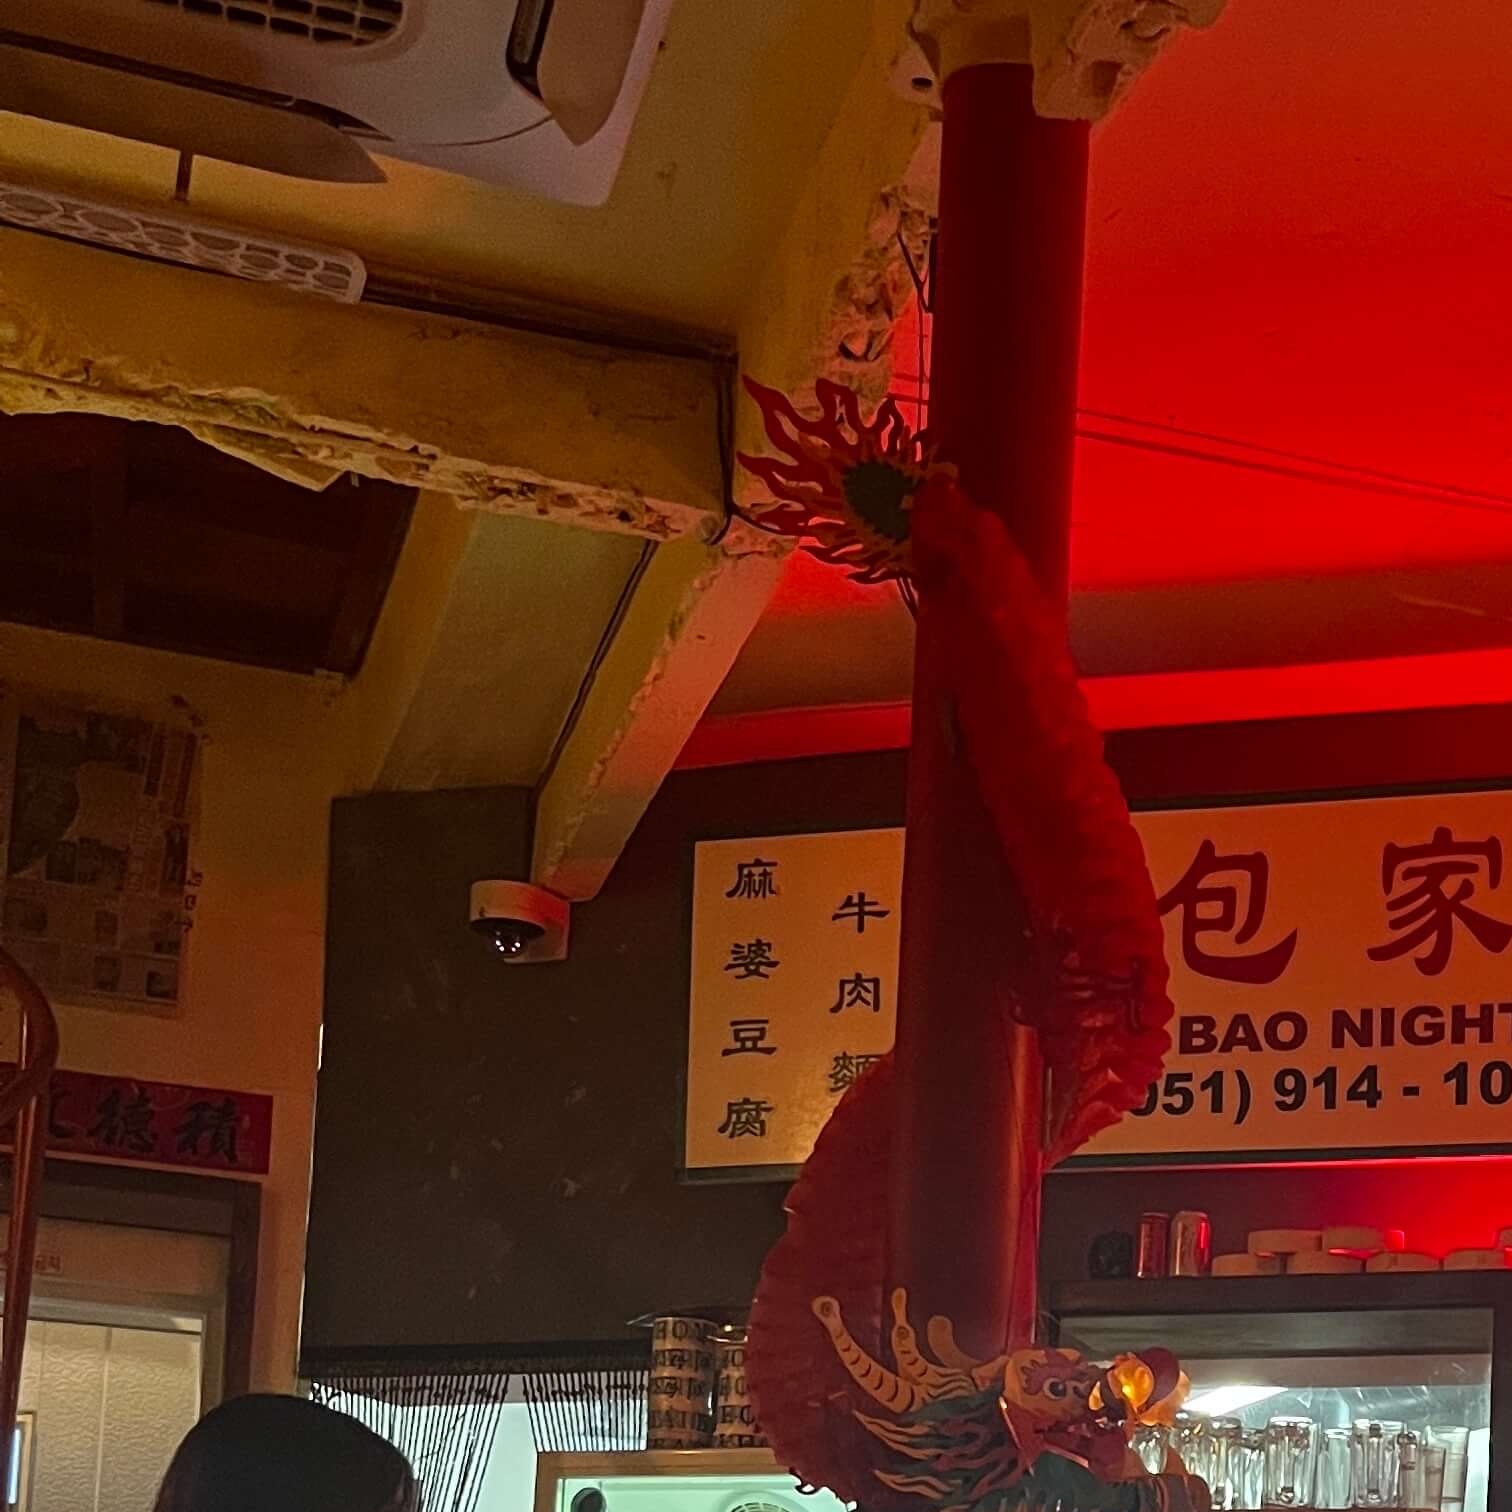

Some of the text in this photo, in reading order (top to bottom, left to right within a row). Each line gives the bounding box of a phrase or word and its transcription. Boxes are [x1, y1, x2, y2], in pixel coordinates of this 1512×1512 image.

[717, 858, 781, 1139] 麻婆豆腐
[1177, 1011, 1309, 1055] BAO
[1272, 1065, 1382, 1113] 914
